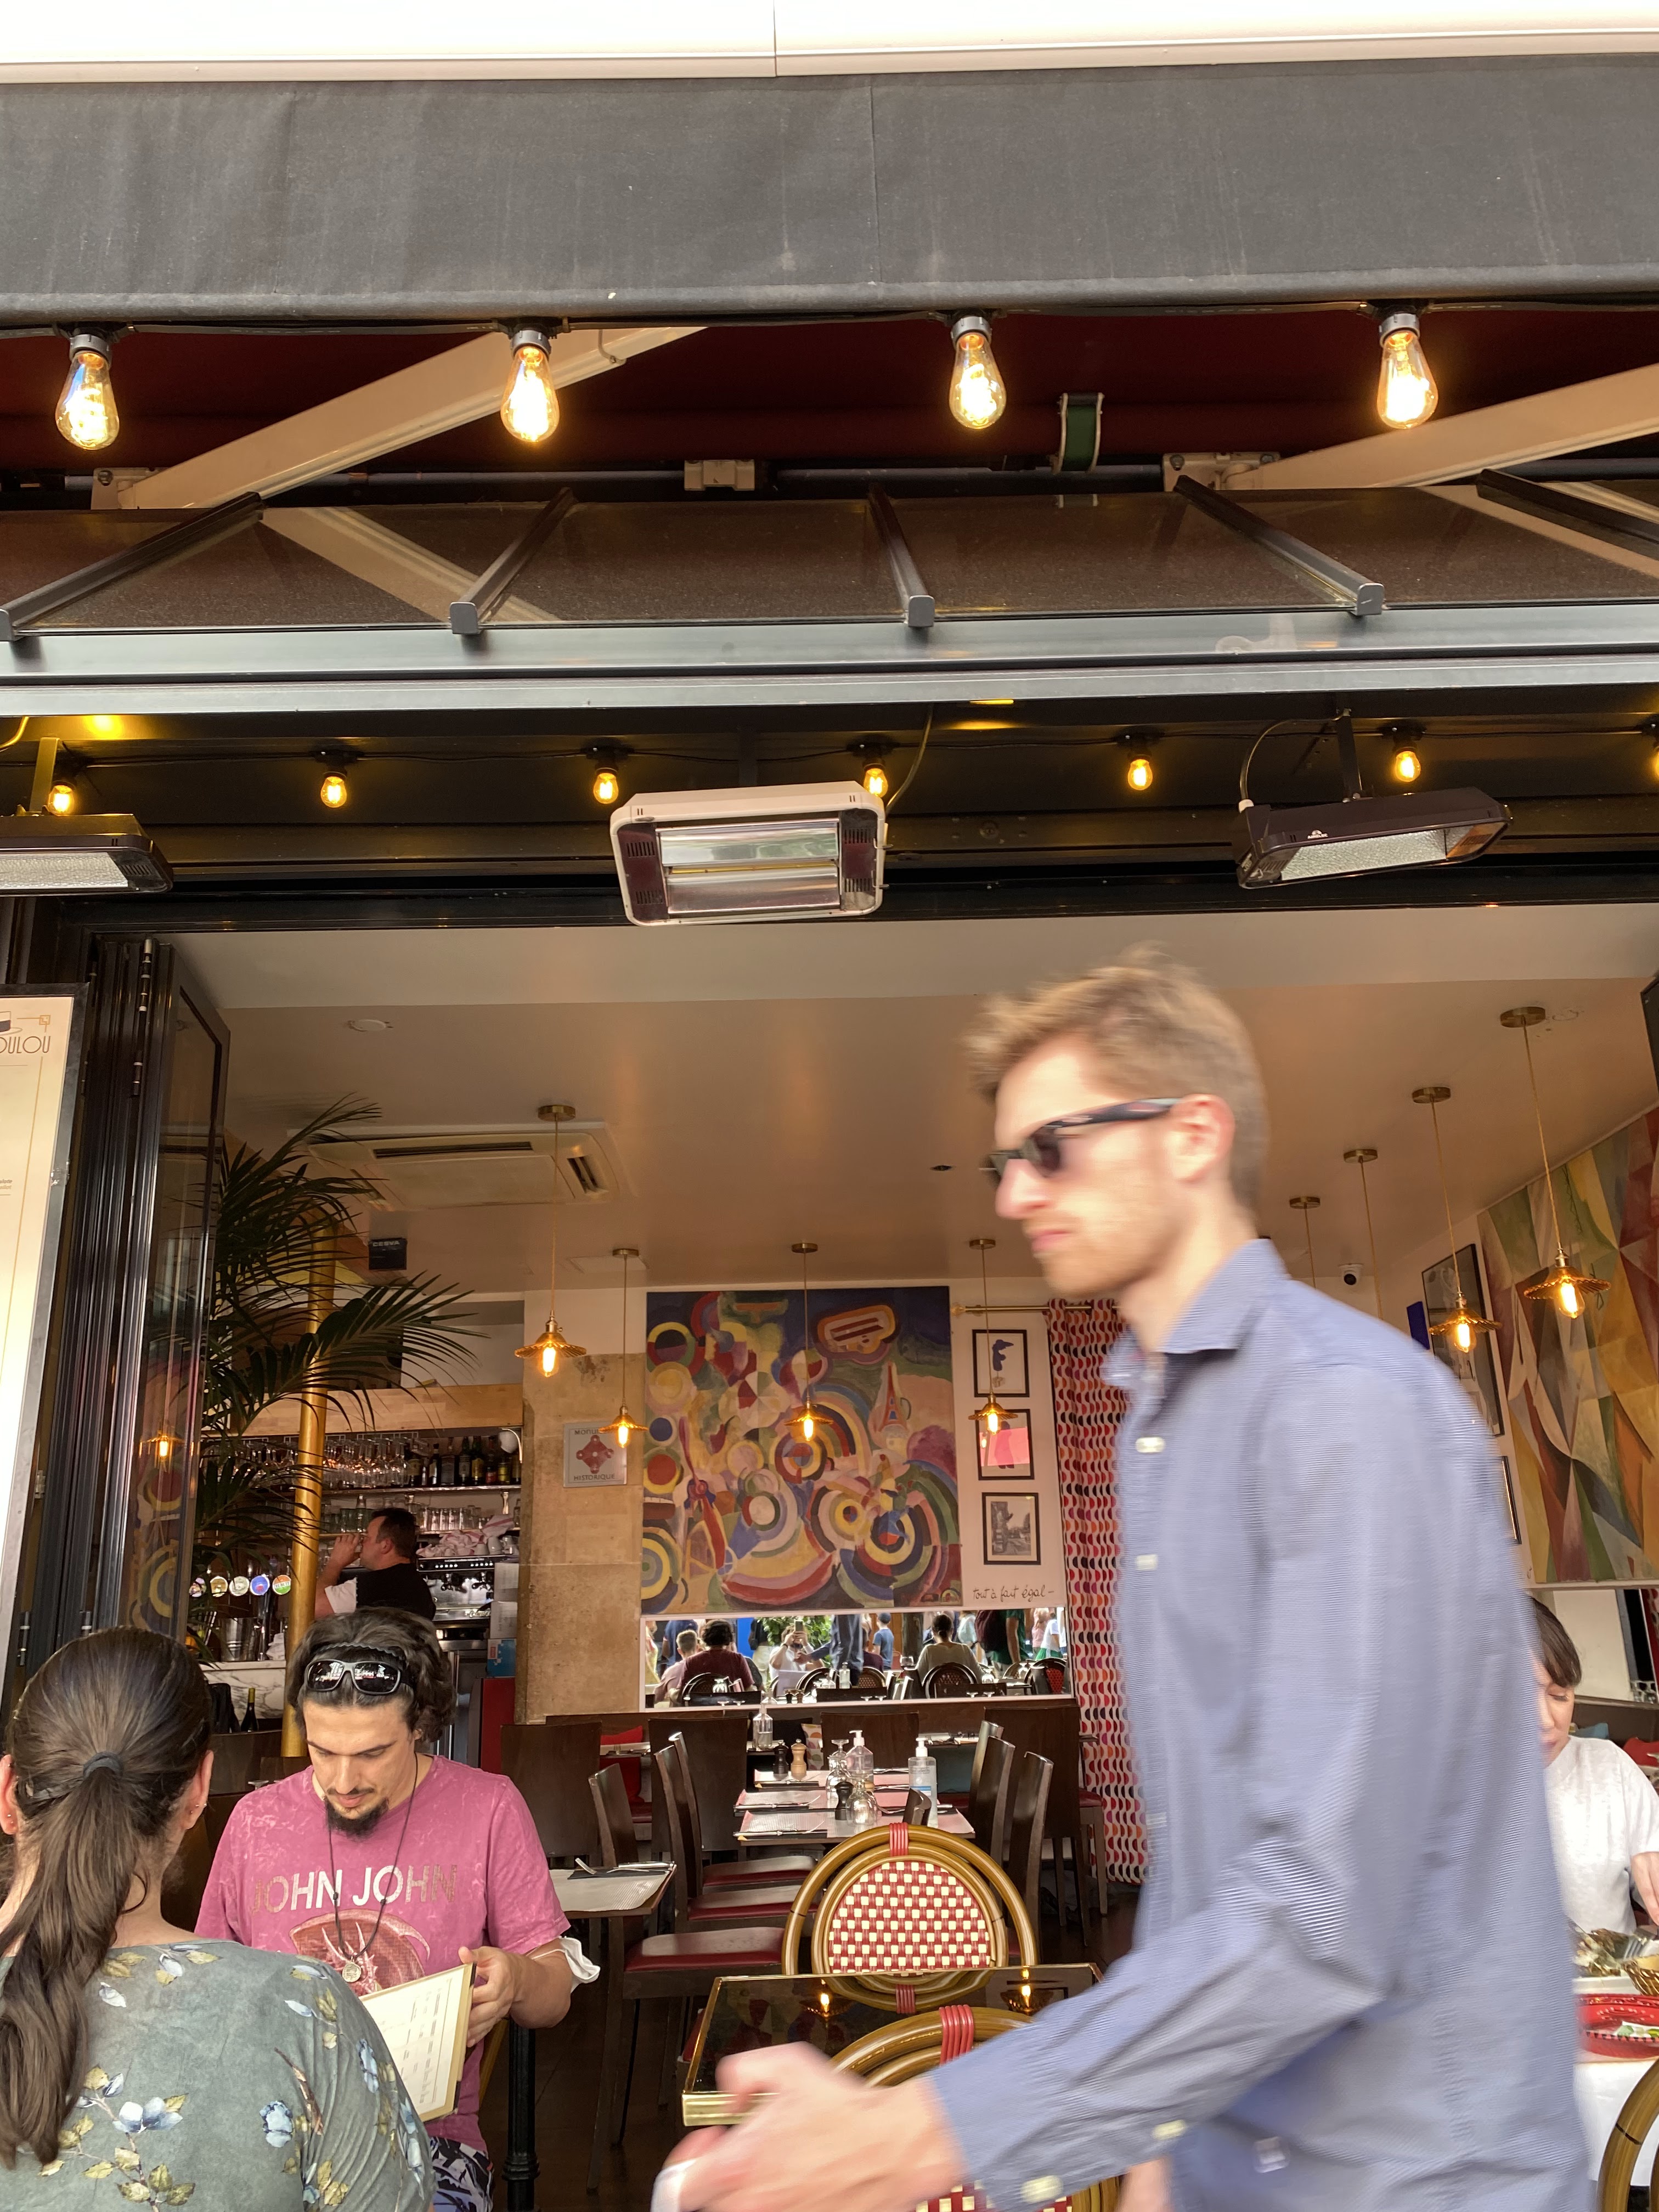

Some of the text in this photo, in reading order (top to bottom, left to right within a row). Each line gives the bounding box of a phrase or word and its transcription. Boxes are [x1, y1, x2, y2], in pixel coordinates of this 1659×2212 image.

[991, 1588, 997, 1599] à
[1001, 1585, 1019, 1602] fait
[250, 1865, 457, 1915] JOHN JOHN
